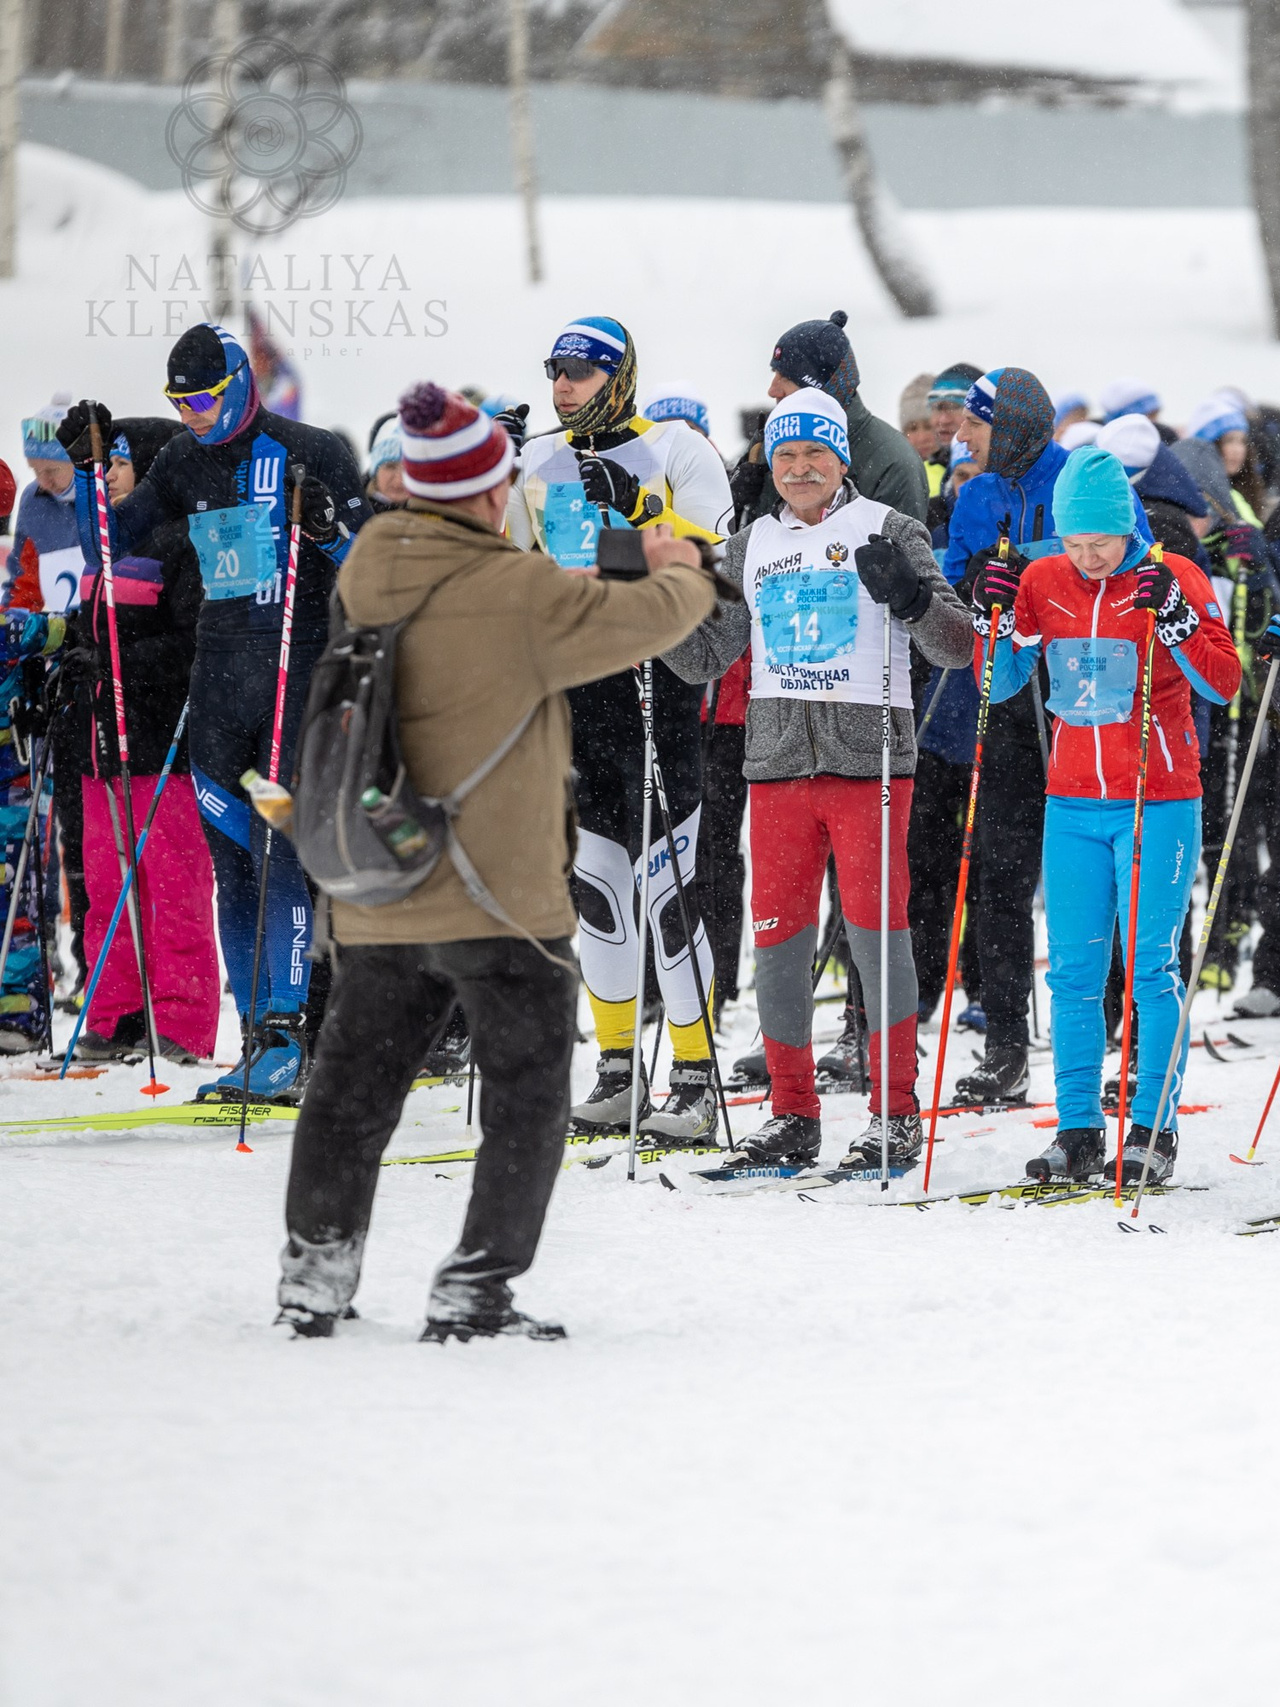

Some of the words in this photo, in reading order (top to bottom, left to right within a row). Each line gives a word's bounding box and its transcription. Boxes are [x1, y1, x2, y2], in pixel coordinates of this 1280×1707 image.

[214, 549, 239, 579] 20
[754, 552, 803, 582] ЛЫЖНЯ
[789, 611, 821, 643] 14
[768, 664, 850, 681] КОСТРОМСКАЯ
[780, 677, 835, 691] ОБЛАСТЬ
[983, 660, 993, 696] LEKI
[882, 664, 891, 749] salomon
[1142, 703, 1151, 739] LEKI
[289, 906, 306, 985] SPINE
[268, 1057, 299, 1084] SPINE
[219, 1106, 271, 1116] FISCHER
[733, 1166, 780, 1180] salomon
